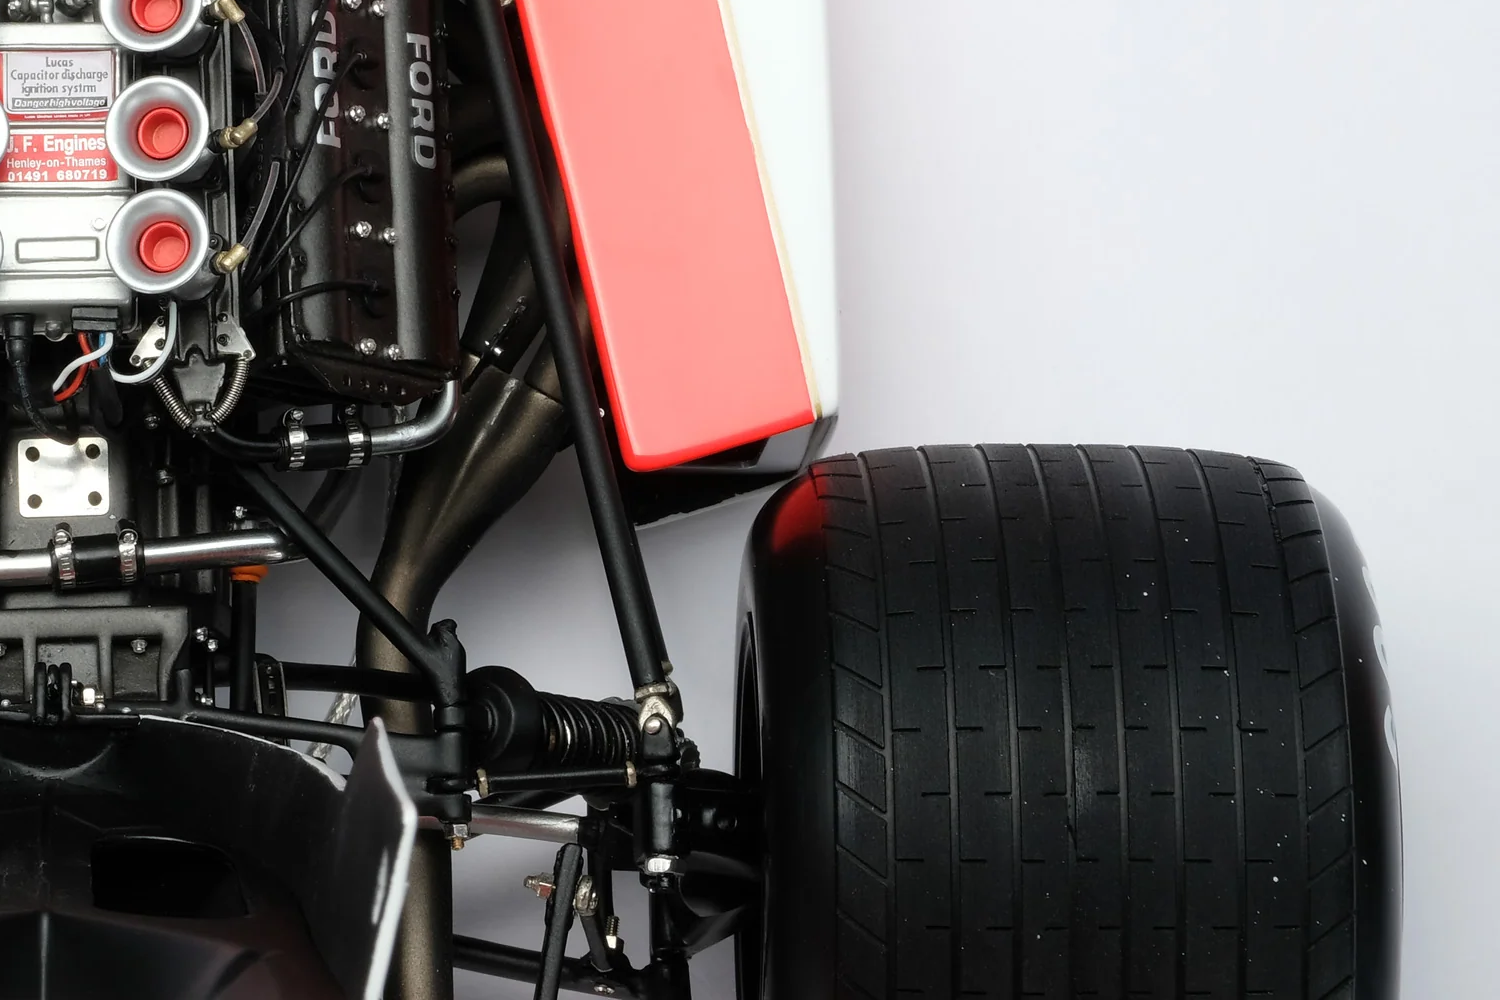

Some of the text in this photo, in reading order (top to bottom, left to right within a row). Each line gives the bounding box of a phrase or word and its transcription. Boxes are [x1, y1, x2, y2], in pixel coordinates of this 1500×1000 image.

[45, 56, 74, 68] Lucas
[10, 68, 109, 83] Capacitor discharge
[21, 82, 59, 97] ignition
[406, 32, 437, 170] FORD
[23, 135, 37, 152] F.
[43, 134, 106, 155] Engines
[6, 156, 106, 171] Henley-on-Thames
[7, 169, 108, 182] 01491 680719
